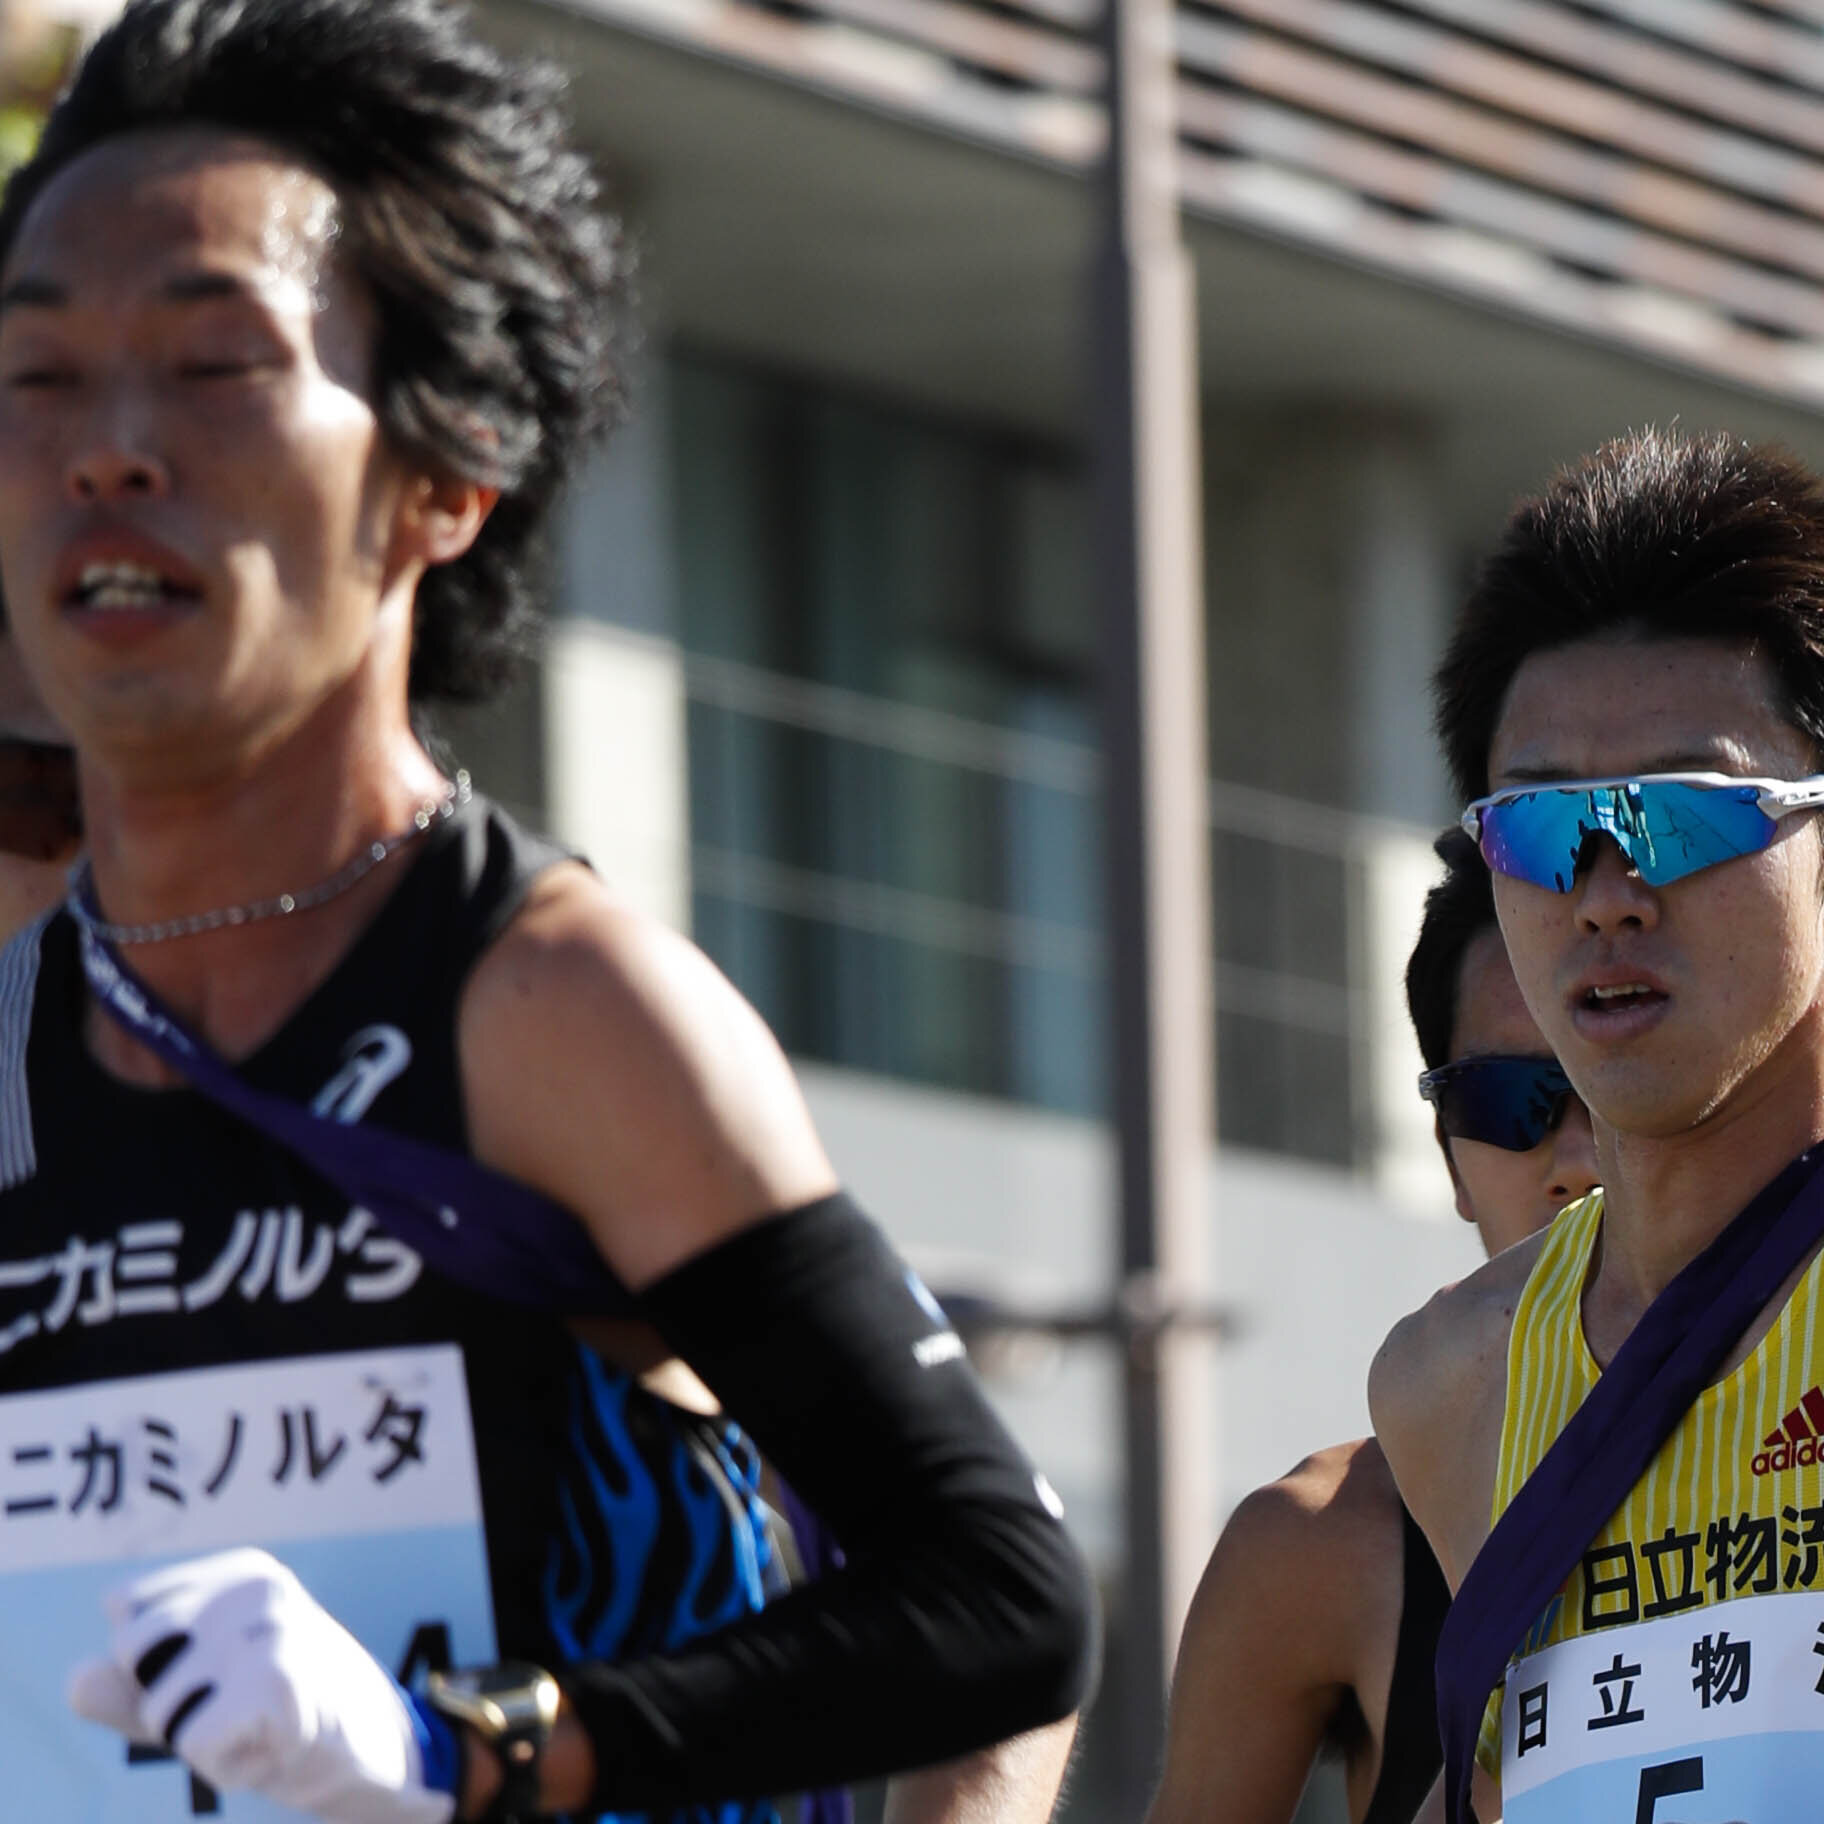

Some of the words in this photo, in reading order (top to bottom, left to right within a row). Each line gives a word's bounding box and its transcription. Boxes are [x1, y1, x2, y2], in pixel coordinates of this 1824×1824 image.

[5, 1394, 427, 1517] ニカミノルタ
